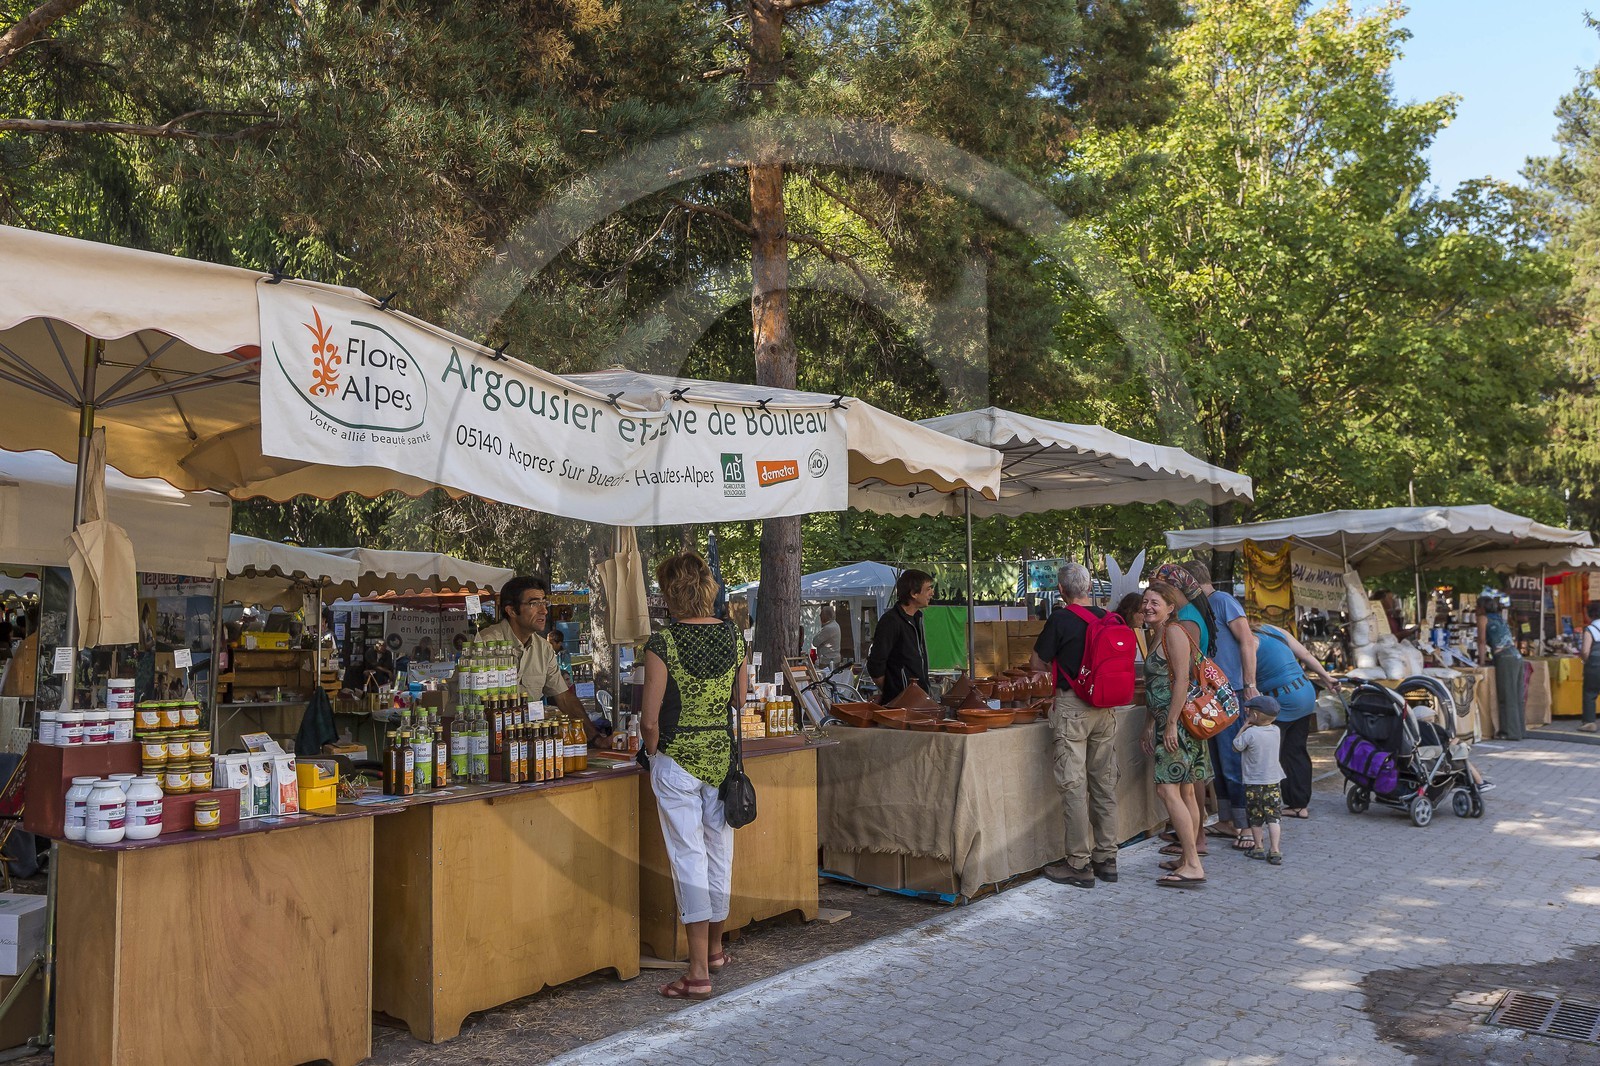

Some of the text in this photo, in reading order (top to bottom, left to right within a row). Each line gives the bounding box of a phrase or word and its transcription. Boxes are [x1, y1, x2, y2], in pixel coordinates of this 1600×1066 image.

[346, 337, 407, 376] Flore
[342, 375, 413, 411] Alpes
[441, 346, 603, 433] Argousier
[708, 404, 736, 436] de
[742, 407, 826, 436] Bouleau
[309, 410, 432, 446] Votre allié beauté santé
[456, 424, 502, 456] 05140
[508, 442, 554, 474] Aspres
[559, 458, 585, 481] Sur
[635, 466, 714, 487] Hautes-Alpes
[724, 462, 742, 480] AB
[761, 465, 795, 481] demeter
